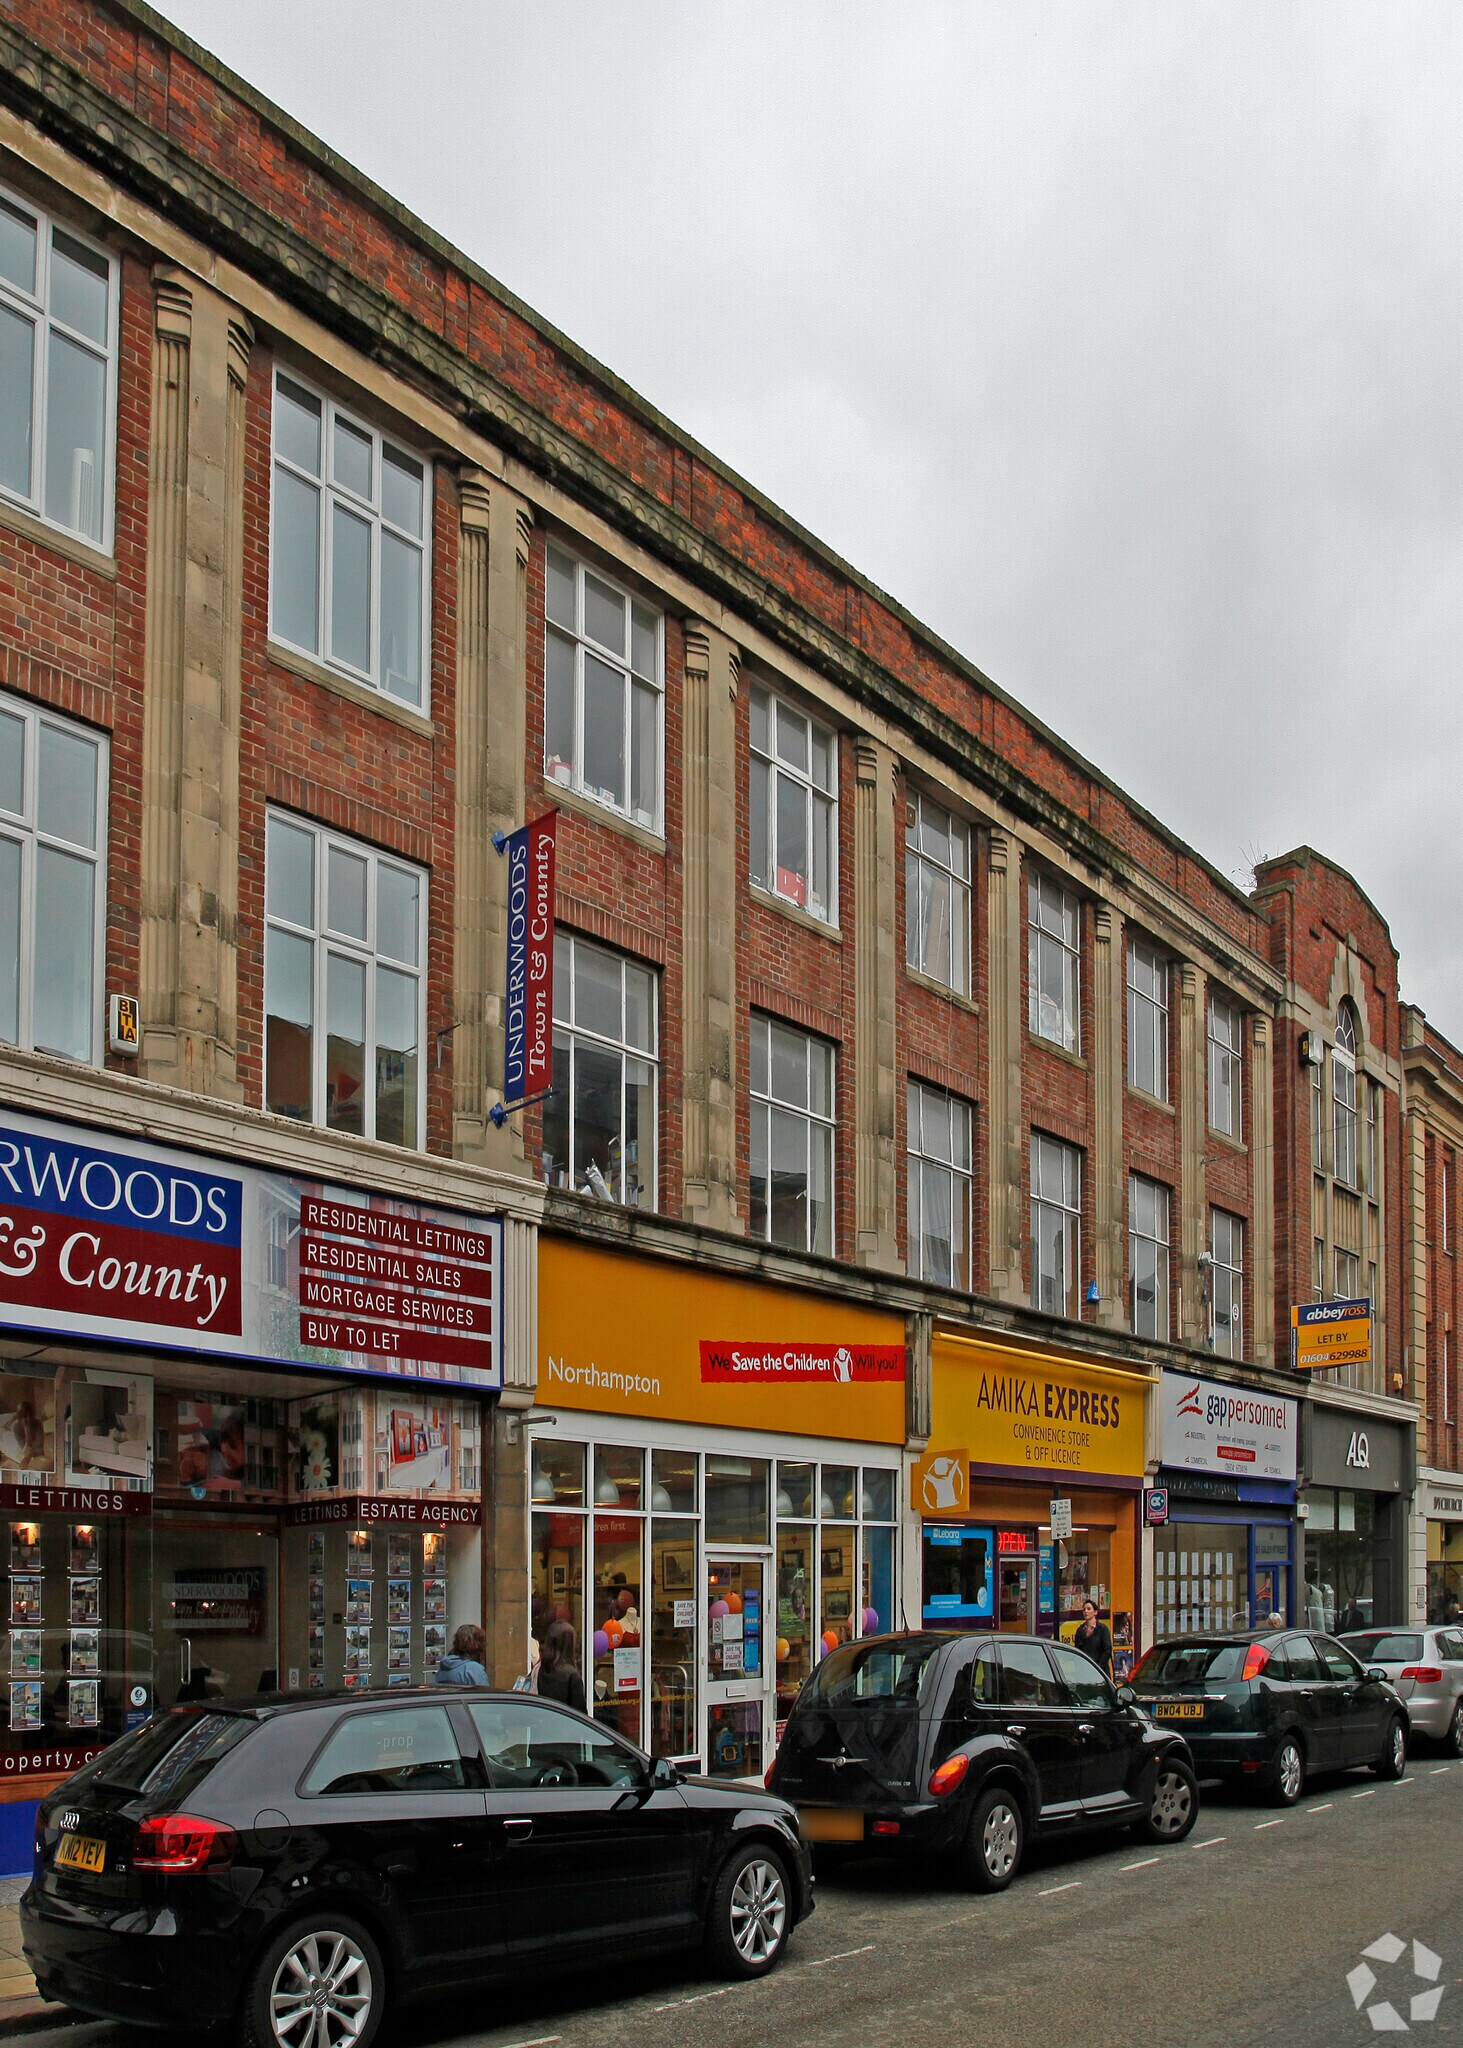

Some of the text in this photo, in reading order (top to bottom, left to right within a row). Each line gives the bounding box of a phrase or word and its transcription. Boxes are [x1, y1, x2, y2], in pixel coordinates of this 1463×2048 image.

[508, 845, 527, 1084] UNDERWOODS
[529, 833, 555, 1076] Town & County
[308, 1204, 485, 1257] RESIDENTIAL LETTINGS
[307, 1243, 461, 1288] RESIDENTIAL SALES
[59, 1232, 227, 1324] County
[307, 1282, 474, 1326] MORTGAGE SERVICES
[1306, 1306, 1367, 1320] abbeyross
[308, 1321, 400, 1351] BUY TO LET
[1317, 1332, 1348, 1344] LET BY
[708, 1351, 898, 1374] We Save the Children Will you?
[548, 1355, 661, 1396] Northampton
[977, 1372, 1120, 1428] AMIKA EXPRESS
[1013, 1423, 1090, 1447] CONVENIENCE STORE
[1025, 1445, 1081, 1465] & OFF LICENCE
[15, 1489, 123, 1511] LETTINGS
[360, 1502, 479, 1522] ESTATE AGENCY
[295, 1503, 348, 1522] LETTINGS
[939, 1528, 960, 1538] Lebara
[1157, 1704, 1202, 1717] BW04 UBJ
